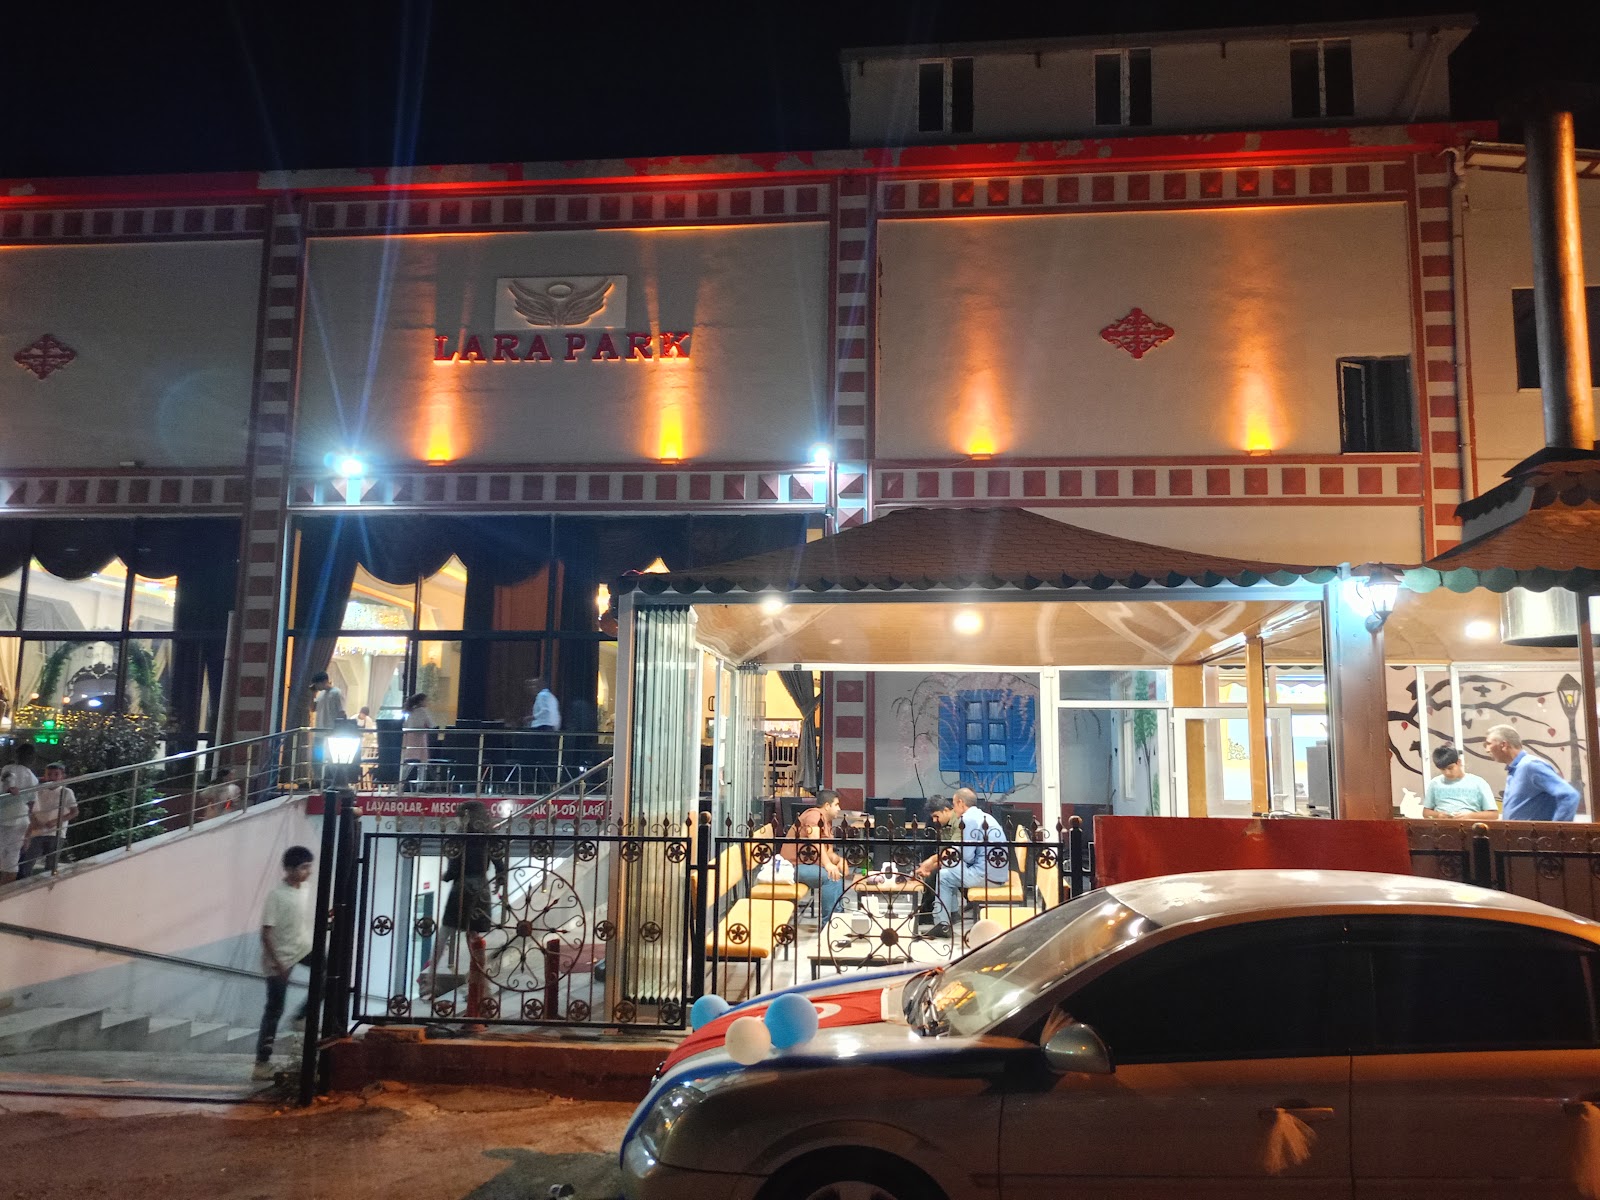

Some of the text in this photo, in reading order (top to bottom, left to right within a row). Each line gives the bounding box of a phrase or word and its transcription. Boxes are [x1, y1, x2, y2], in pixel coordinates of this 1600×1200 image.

[434, 332, 690, 362] LARA PARK
[366, 801, 422, 813] LAVABOLAR
[561, 804, 604, 816] ODLARI
